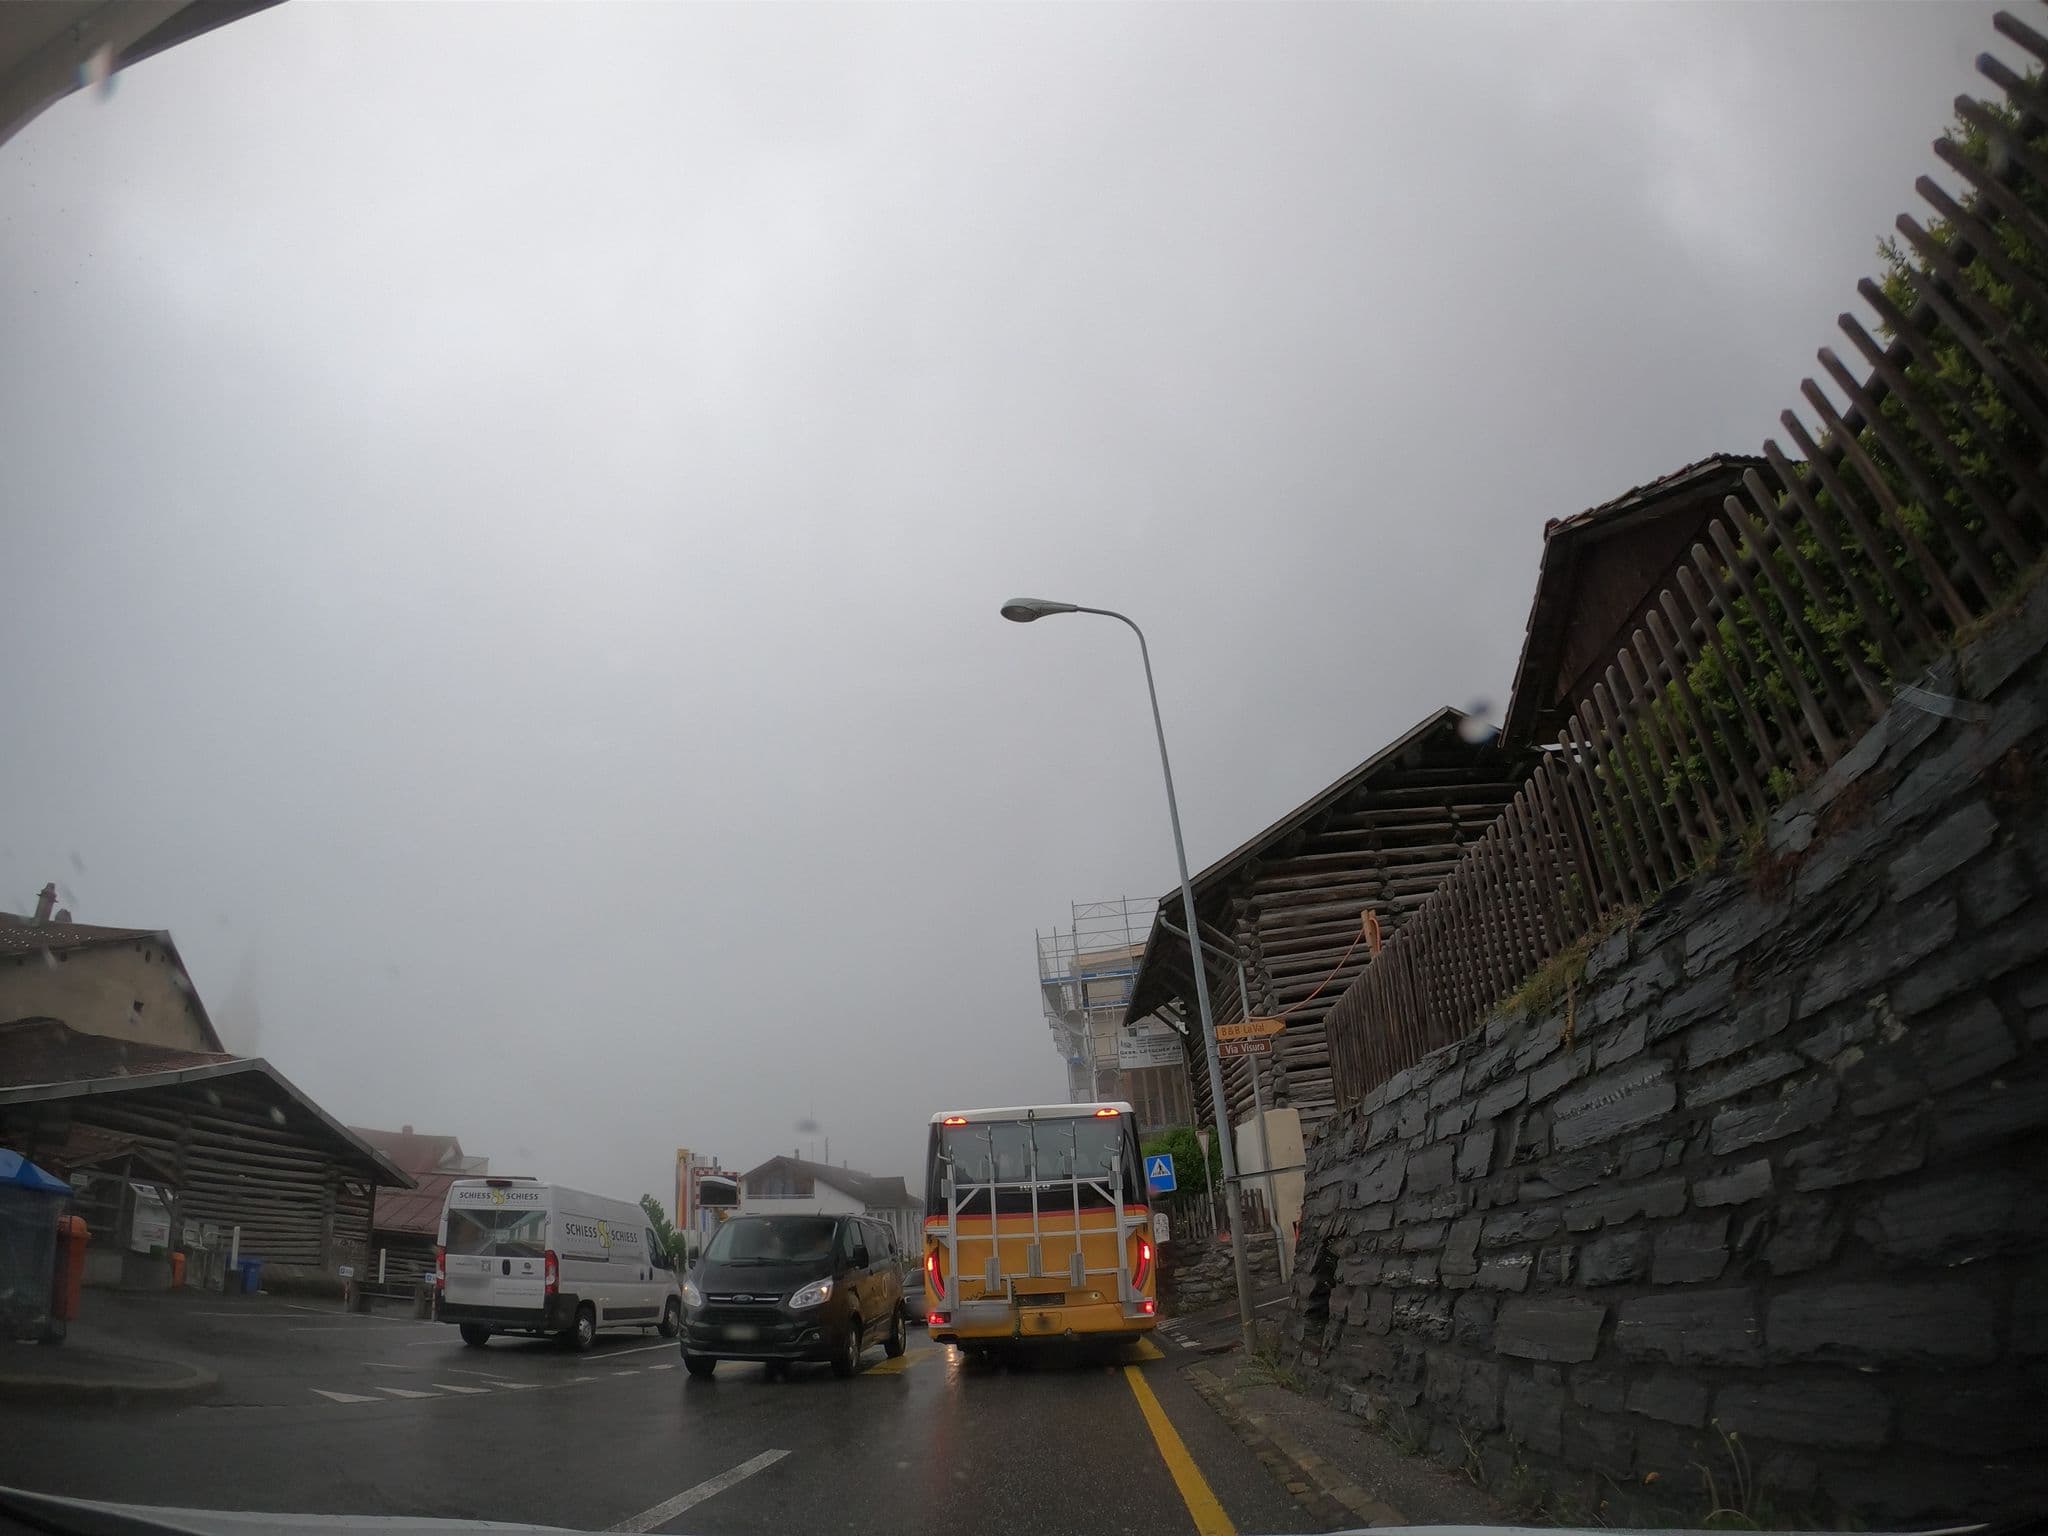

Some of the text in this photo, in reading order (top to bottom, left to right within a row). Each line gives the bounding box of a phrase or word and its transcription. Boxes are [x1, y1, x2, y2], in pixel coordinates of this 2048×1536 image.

[1225, 1043, 1265, 1054] Via Visura
[459, 1191, 538, 1200] SCHIESS SCHIESS
[566, 1223, 597, 1239] SCHIESS
[612, 1230, 638, 1243] SCHIESS
